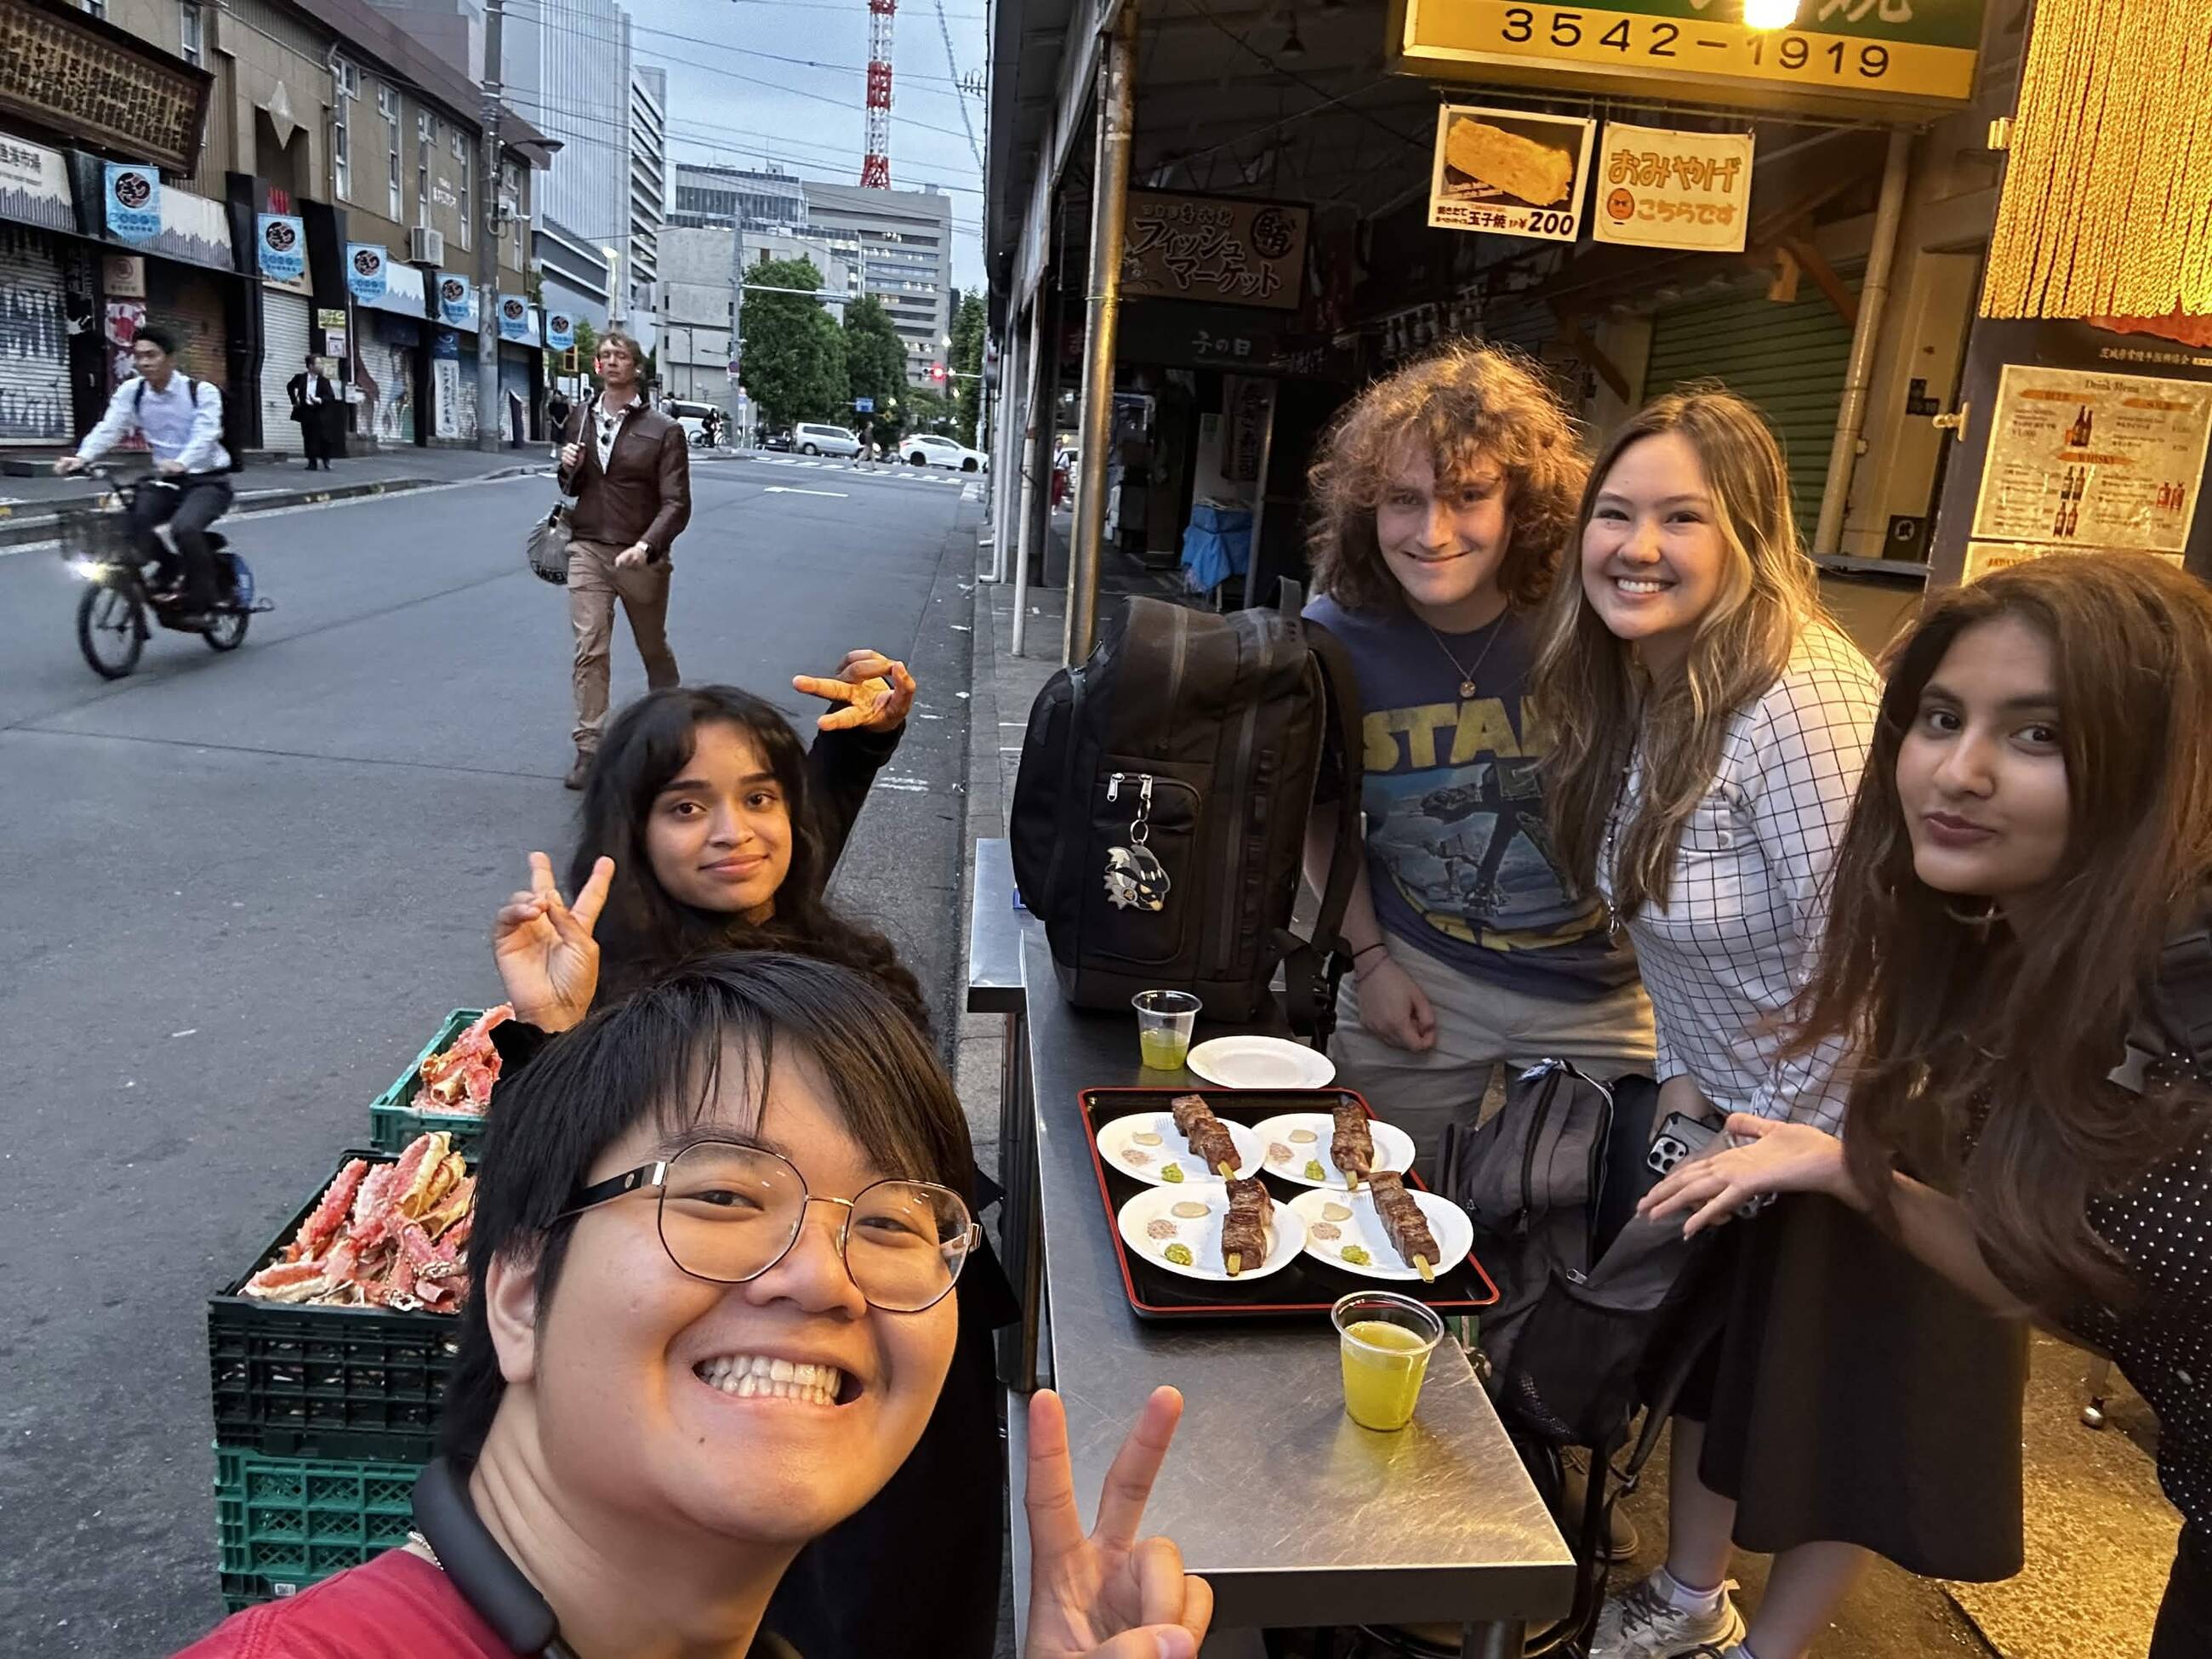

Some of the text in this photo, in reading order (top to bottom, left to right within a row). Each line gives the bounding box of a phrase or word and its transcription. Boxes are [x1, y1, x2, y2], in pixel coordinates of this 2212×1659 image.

[1502, 8, 1889, 77] 3542-1919
[1608, 149, 1742, 192] おみやげ
[1468, 210, 1507, 229] 玉子焼
[1637, 198, 1737, 225] こちらです
[1132, 217, 1246, 263] フィッシュ
[1163, 255, 1280, 298] マーケット
[1192, 328, 1252, 356] 子の日
